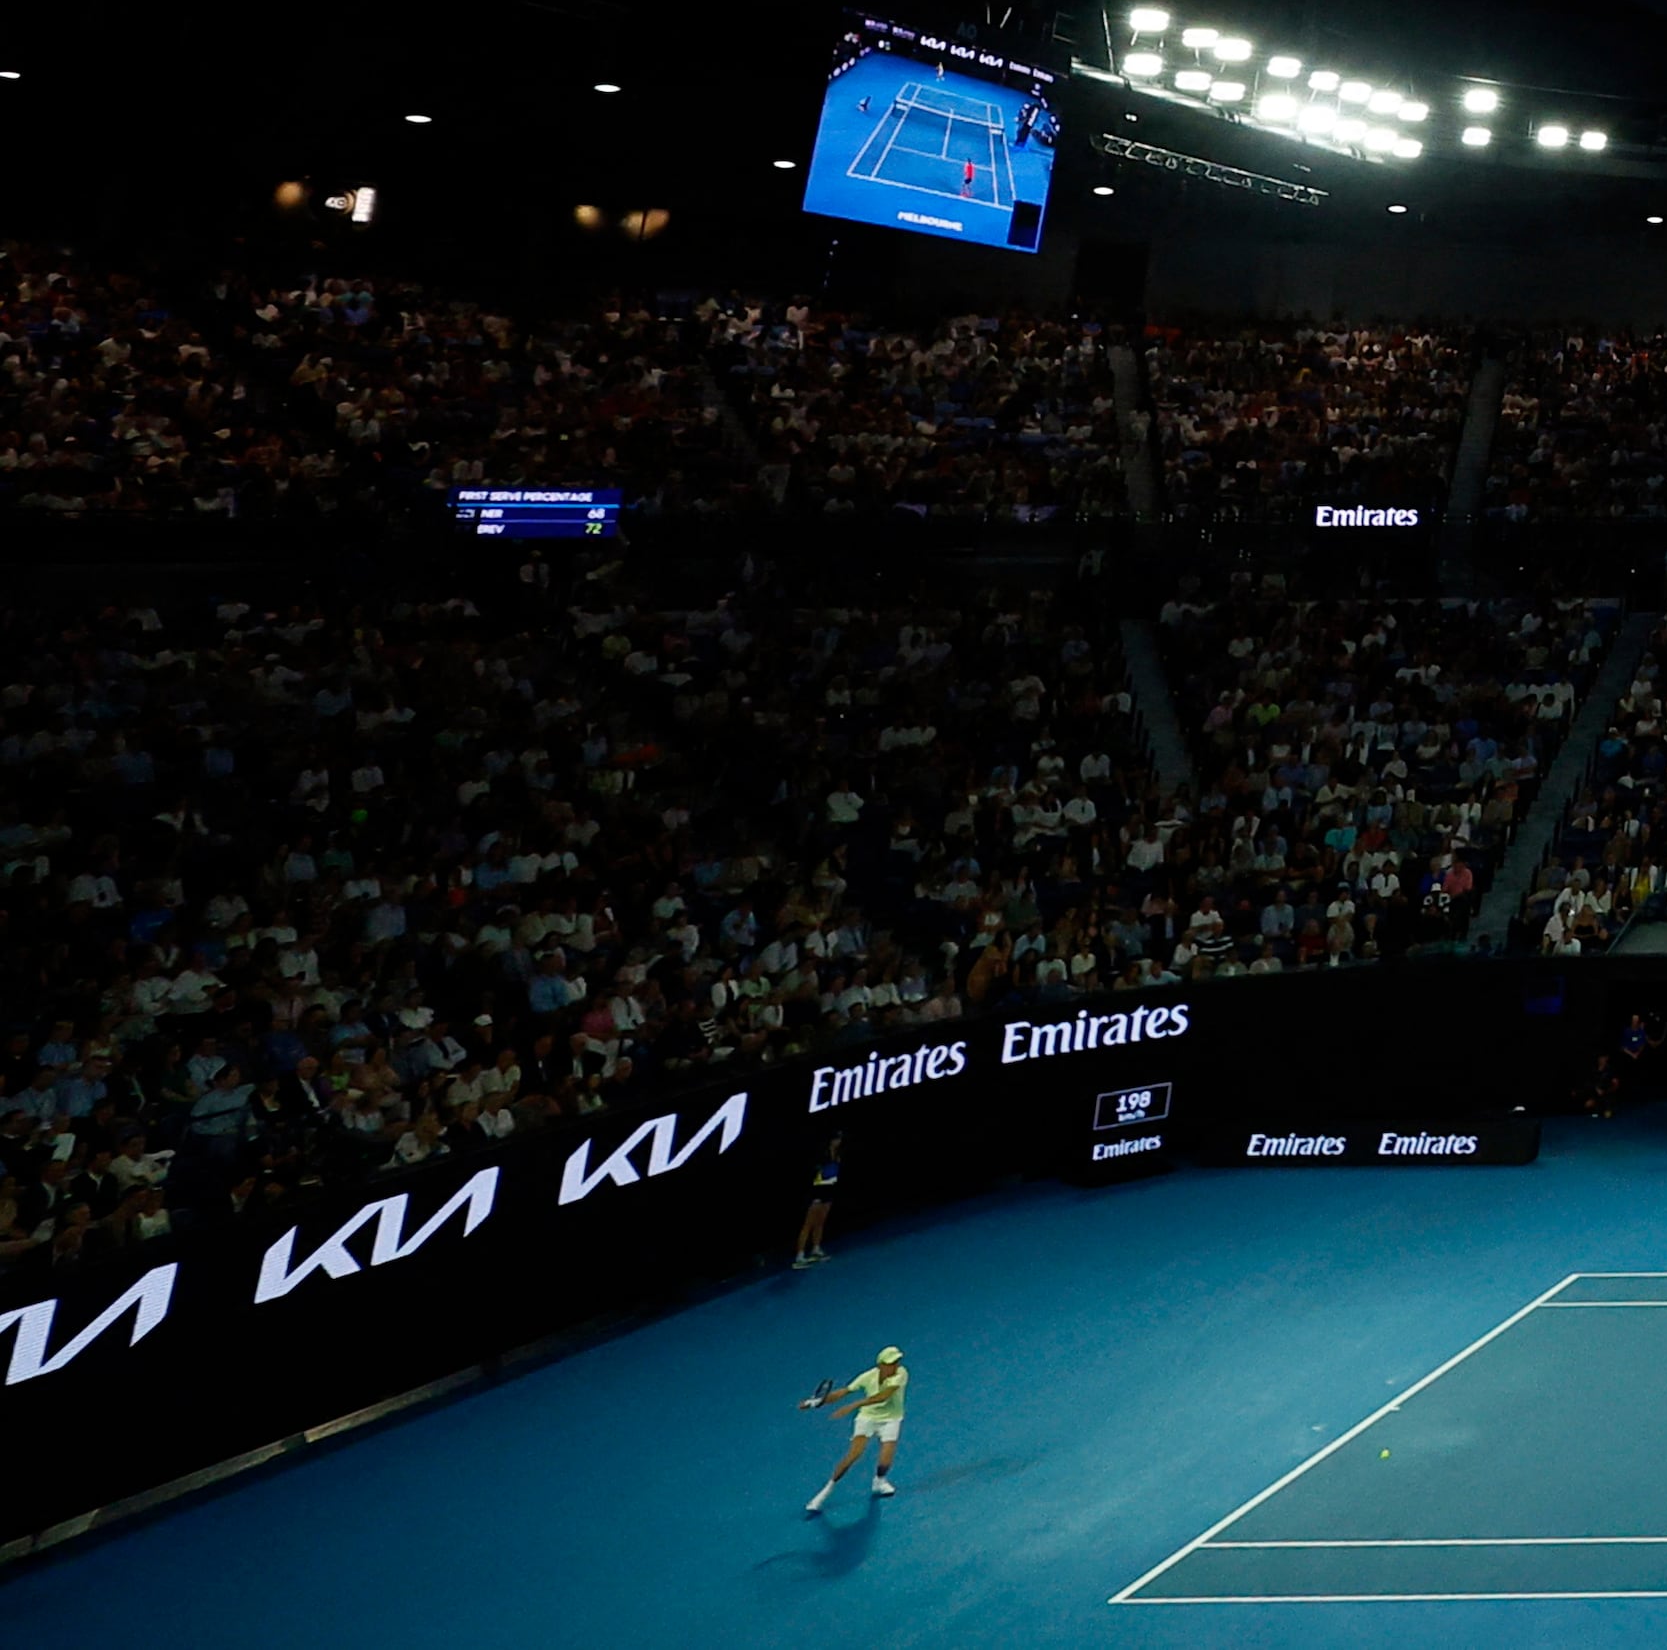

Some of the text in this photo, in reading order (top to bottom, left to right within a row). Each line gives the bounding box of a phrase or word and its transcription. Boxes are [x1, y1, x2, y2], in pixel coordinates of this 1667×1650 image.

[897, 211, 963, 232] MELBOURNE
[587, 508, 605, 519] 68
[1315, 505, 1418, 527] Emirates
[585, 523, 602, 535] 72
[1001, 1004, 1189, 1064] Emirates
[808, 1040, 966, 1113] Emirates
[1116, 1091, 1151, 1113] 198
[558, 1092, 748, 1206] KIA
[1092, 1135, 1161, 1161] Emirates
[1246, 1132, 1346, 1156] Emirates
[1378, 1131, 1478, 1155] Emirates
[254, 1166, 500, 1304] KIA
